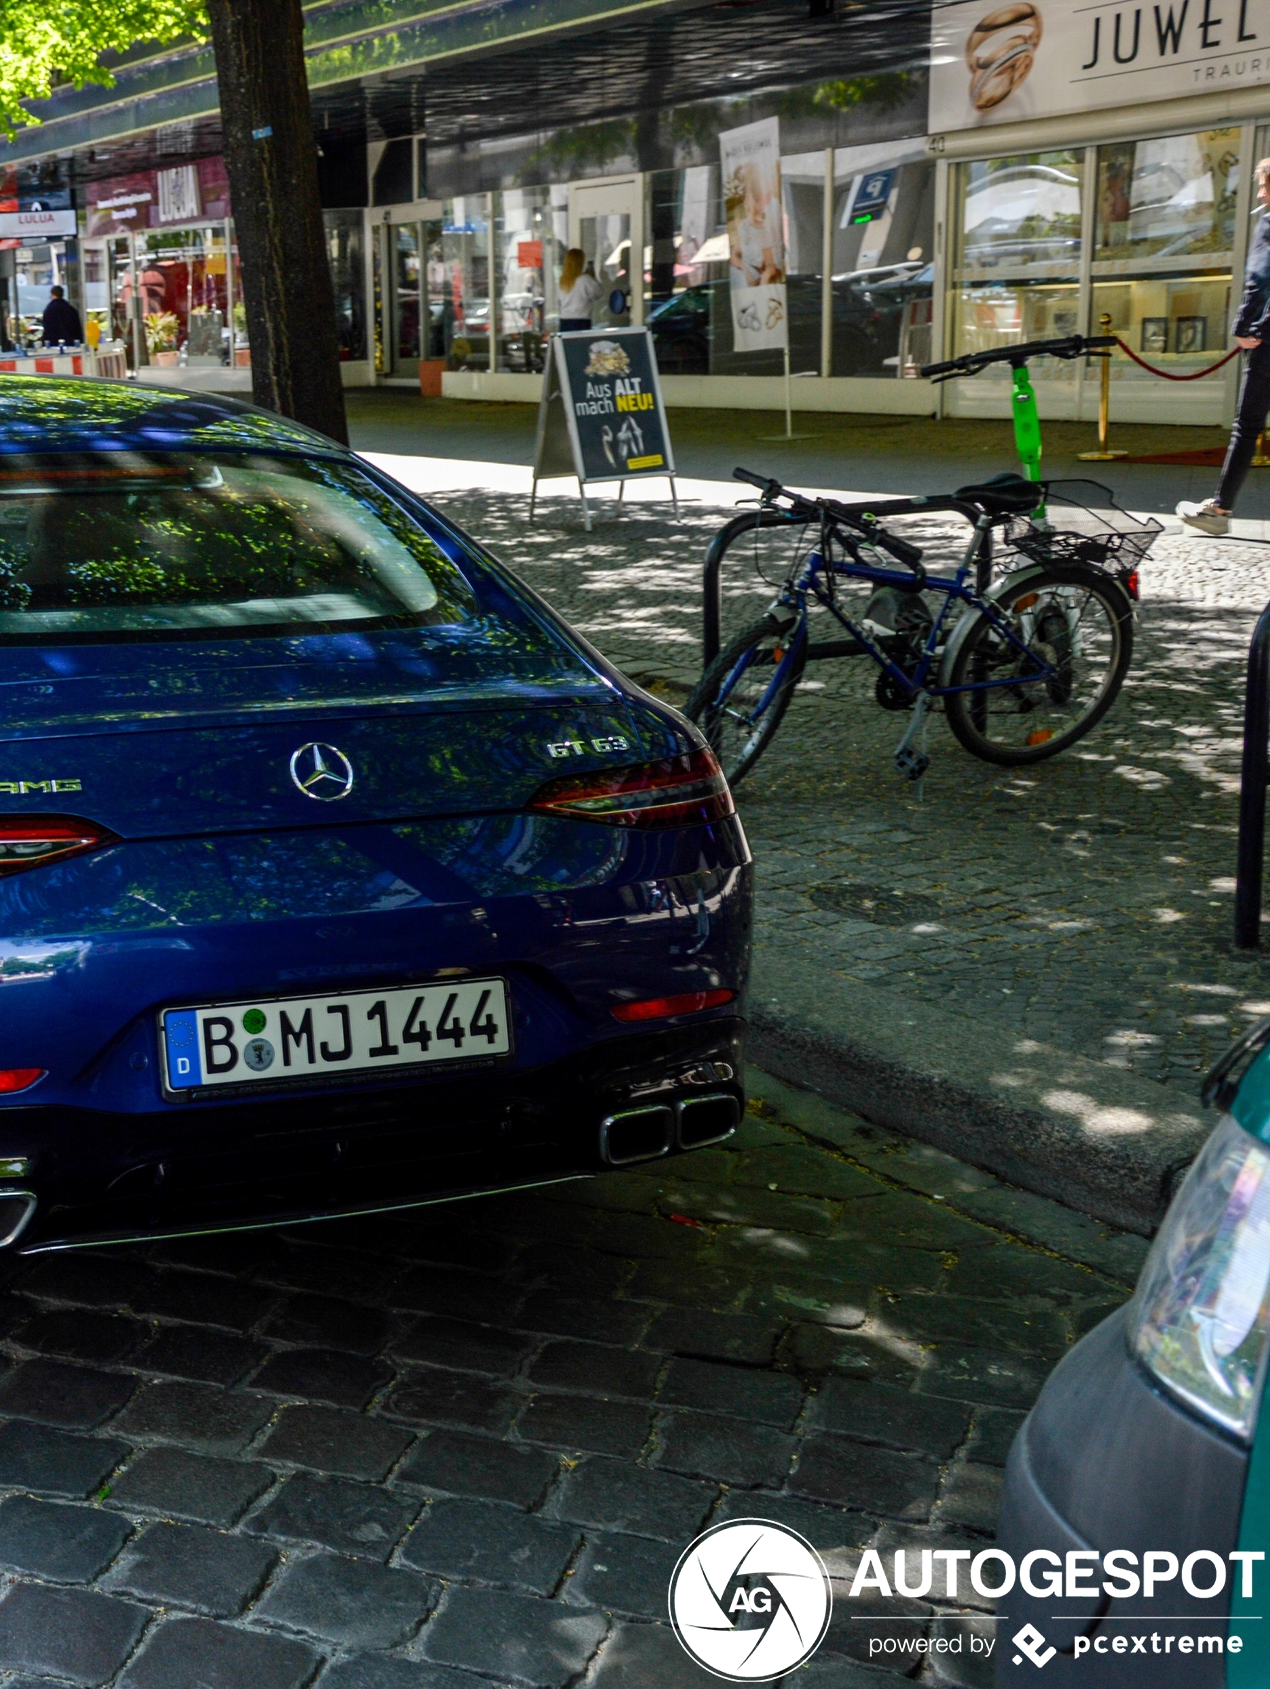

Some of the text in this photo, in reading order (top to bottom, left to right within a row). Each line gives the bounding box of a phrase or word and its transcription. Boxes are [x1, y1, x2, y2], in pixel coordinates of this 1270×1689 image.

[1082, 0, 1257, 70] JUWEL
[929, 136, 945, 153] 40
[18, 213, 55, 225] LULUA
[586, 378, 641, 398] Aus ALT
[576, 393, 654, 416] mach NEU!
[546, 736, 630, 758] GT 63
[202, 1016, 238, 1075] B
[279, 1004, 353, 1067] MJ
[367, 989, 499, 1058] 1444
